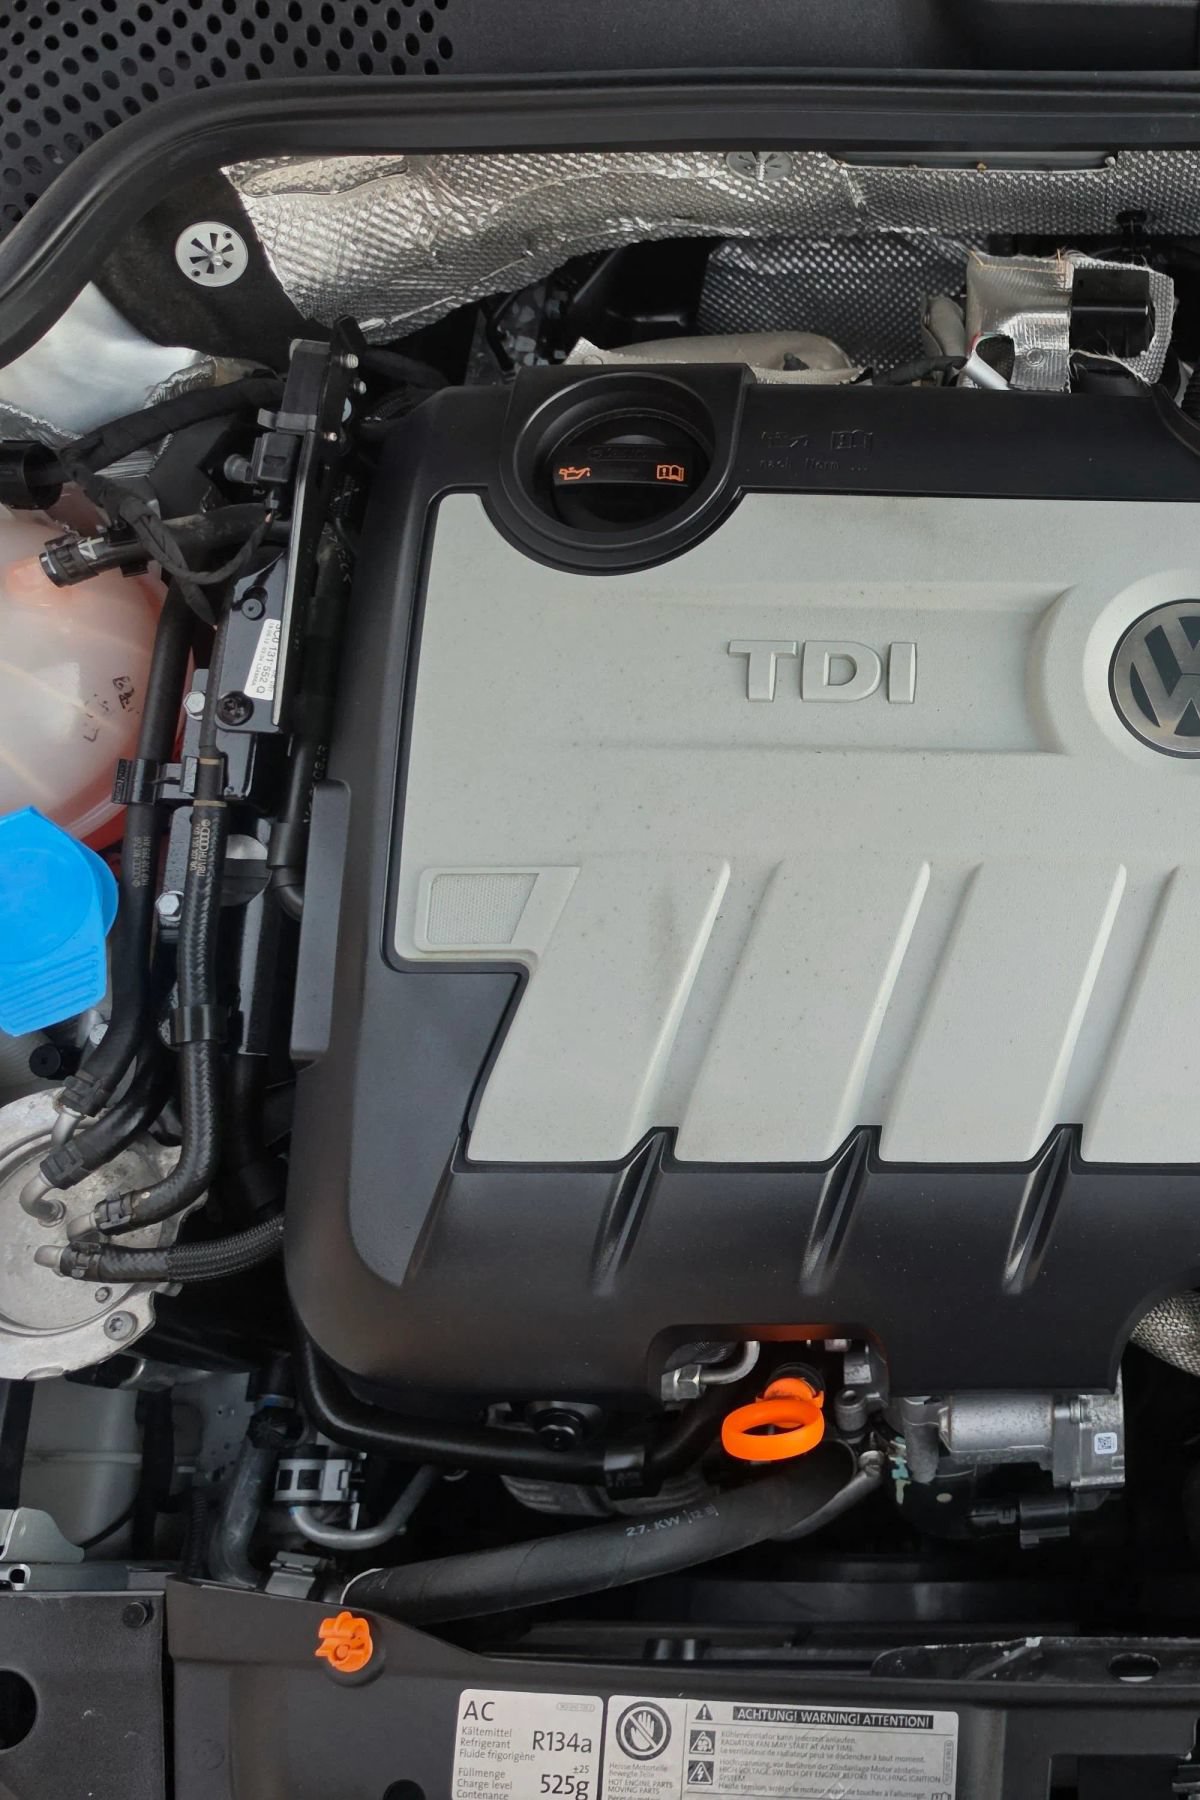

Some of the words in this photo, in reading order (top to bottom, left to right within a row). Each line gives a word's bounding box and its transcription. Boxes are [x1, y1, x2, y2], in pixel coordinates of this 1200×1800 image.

[727, 639, 919, 705] TDI
[463, 1701, 495, 1721] AC
[738, 1708, 797, 1721] ACHTUNG!
[801, 1711, 860, 1725] WARNING!
[862, 1714, 929, 1728] ATTENTION!
[462, 1726, 512, 1738] Kältemittel
[461, 1738, 511, 1749] Refrigerant
[532, 1730, 592, 1753] R134a
[460, 1750, 486, 1759] Fluide
[487, 1752, 536, 1763] frigorigène
[458, 1767, 506, 1780] Füllmenge
[573, 1765, 590, 1774] ±25
[457, 1778, 489, 1789] Charge
[491, 1780, 513, 1789] level
[540, 1774, 590, 1800] 525g
[456, 1789, 509, 1800] Contenance
